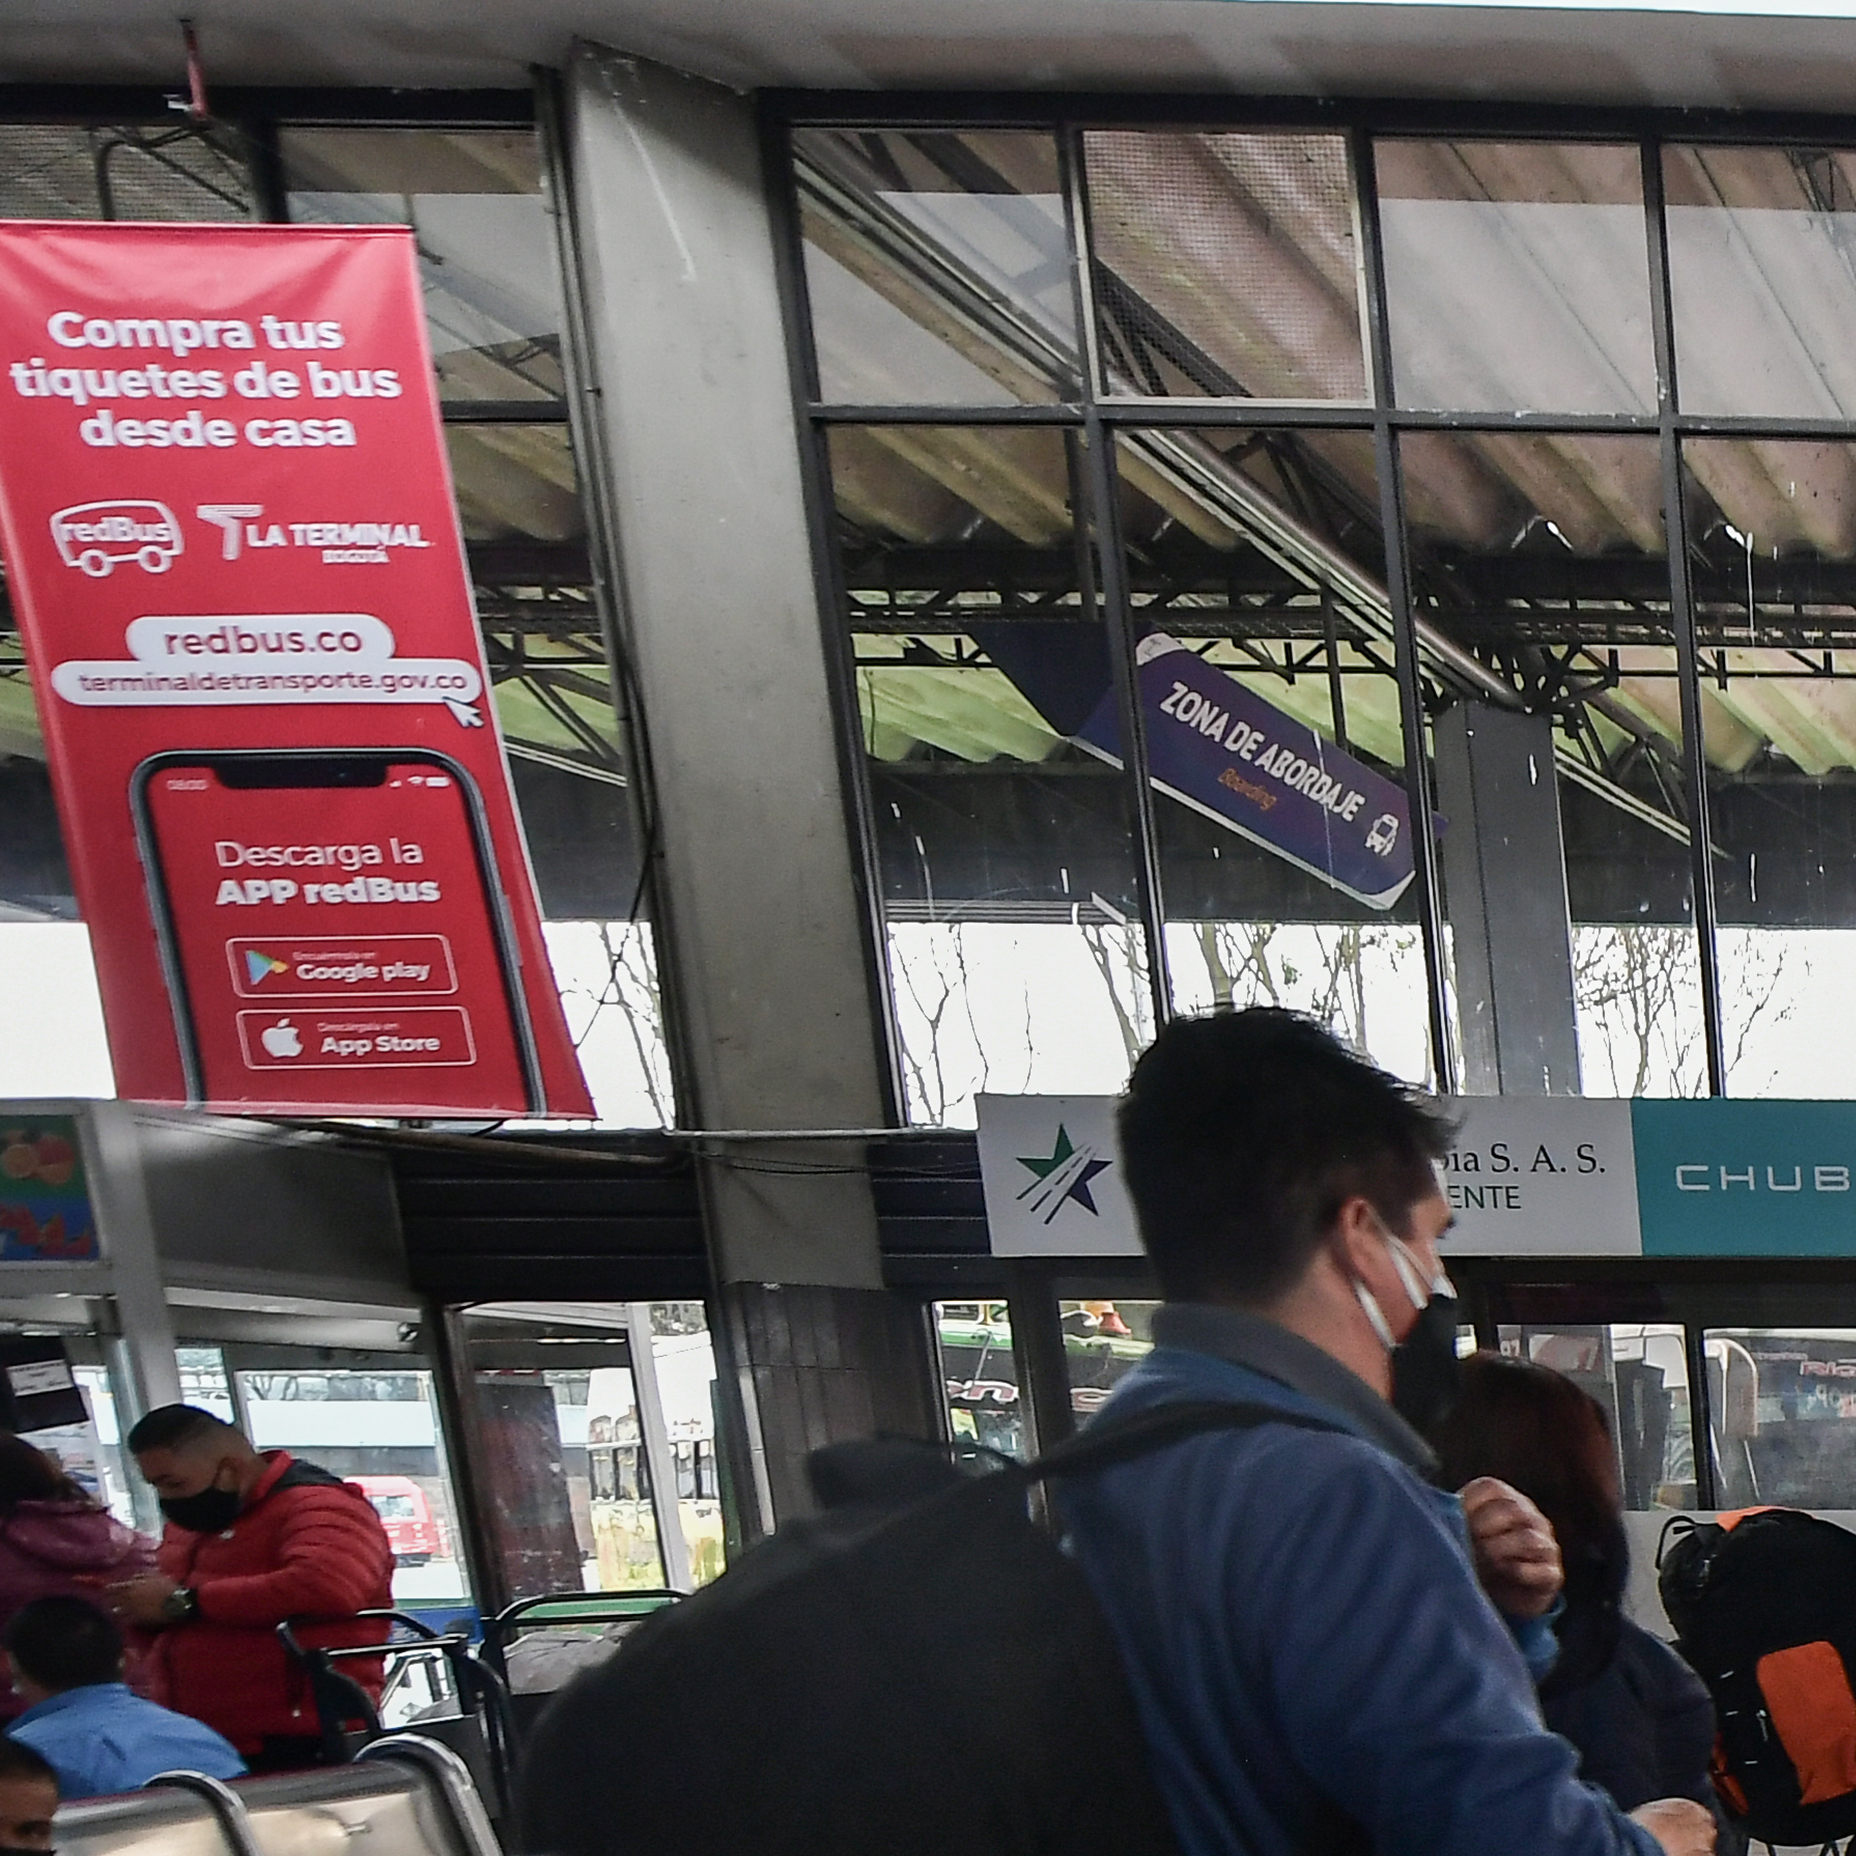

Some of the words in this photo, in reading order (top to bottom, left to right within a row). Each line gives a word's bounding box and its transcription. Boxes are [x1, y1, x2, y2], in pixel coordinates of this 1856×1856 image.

[46, 311, 254, 357] Compra
[261, 315, 345, 350] tus
[9, 358, 228, 405] tiquetes
[233, 361, 300, 398] de
[308, 361, 402, 399] bus
[80, 410, 237, 447] desde
[245, 417, 356, 447] casa
[60, 516, 171, 541] redBus
[246, 523, 288, 547] LA
[289, 523, 430, 547] TERMINAL
[164, 626, 362, 656] redbus.co
[79, 671, 467, 695] terminaldetransporte.gov.co
[1160, 681, 1230, 742] ZONA
[1224, 722, 1265, 761] DE
[1254, 744, 1366, 822] ABORDAJE
[215, 840, 384, 872] Descarga
[391, 838, 424, 866] la
[215, 879, 299, 906] APP
[304, 876, 440, 904] redBus
[296, 963, 379, 982] Google
[382, 962, 430, 982] play
[321, 1036, 373, 1056] App
[376, 1035, 440, 1052] Store
[1490, 1142, 1519, 1173] S.
[1530, 1144, 1567, 1173] A.
[1577, 1144, 1606, 1174] S.
[1447, 1185, 1522, 1209] ENTE
